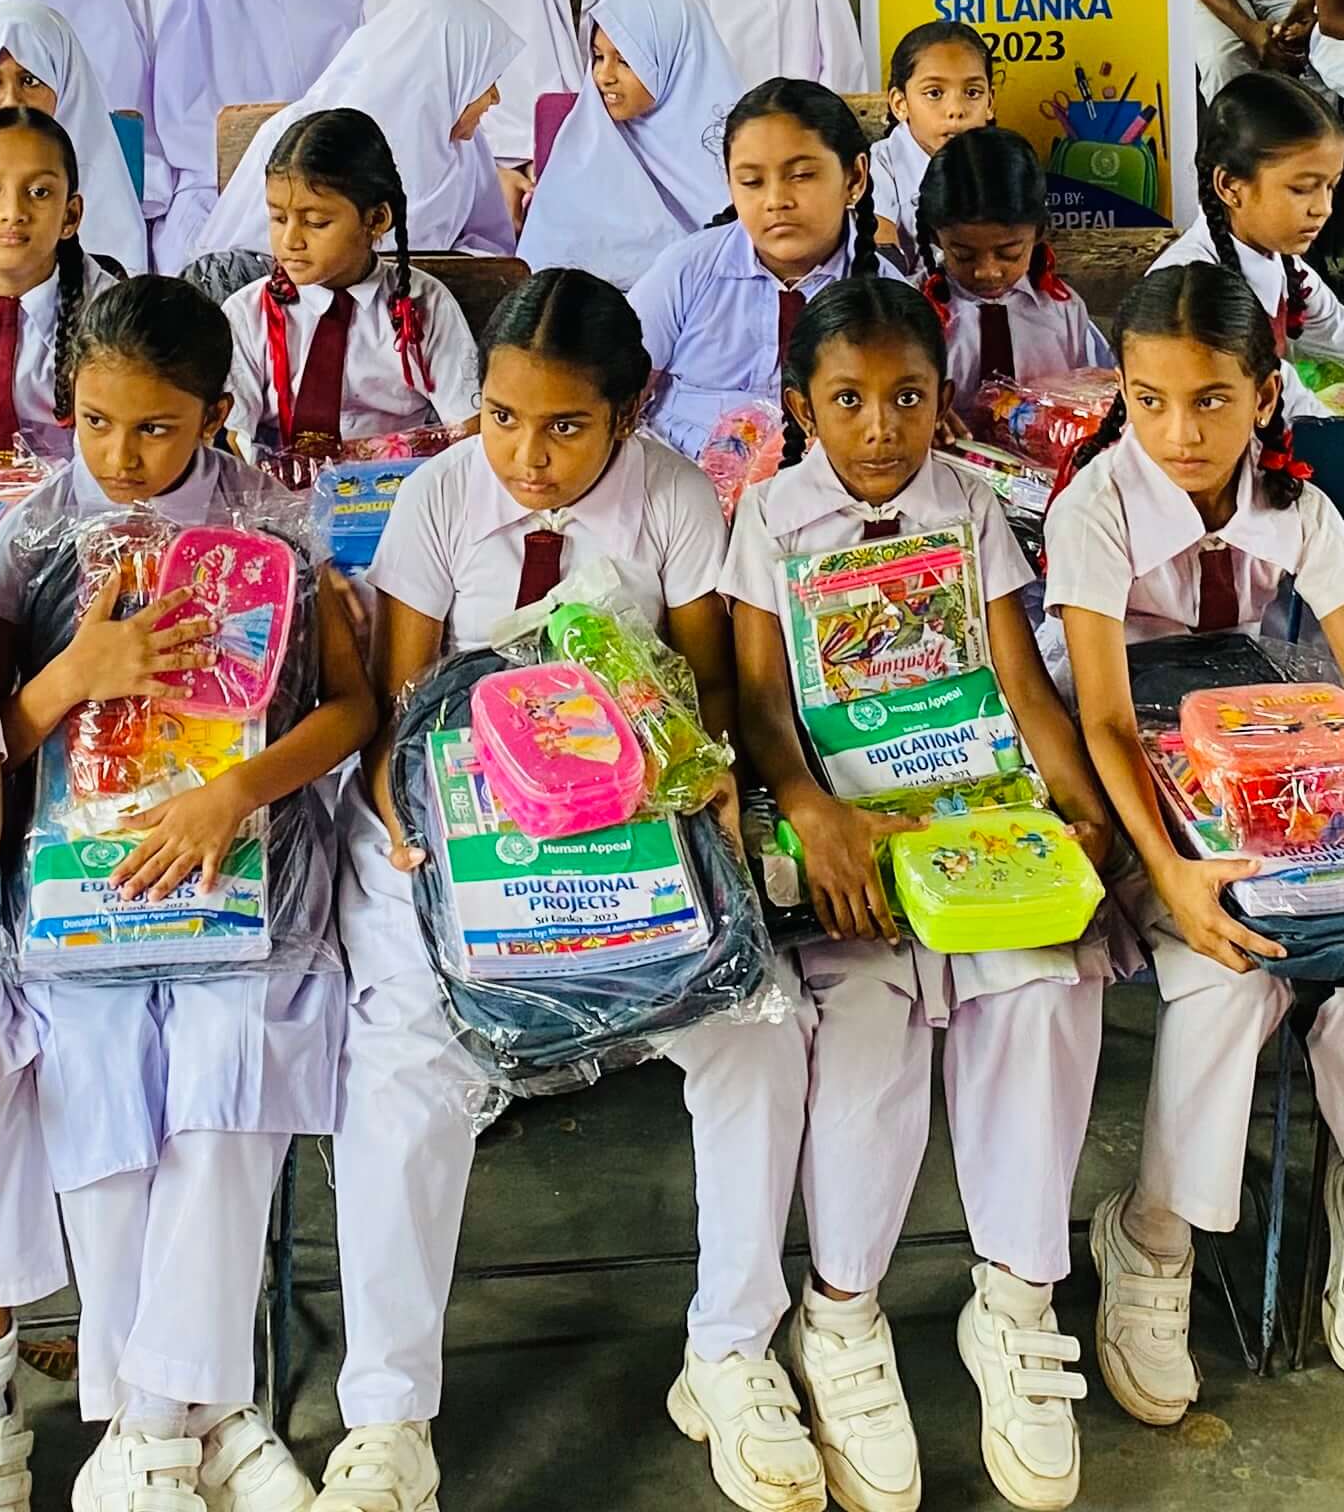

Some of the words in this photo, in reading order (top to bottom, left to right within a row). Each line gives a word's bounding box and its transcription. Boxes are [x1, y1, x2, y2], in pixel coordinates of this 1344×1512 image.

[984, 31, 1066, 63] 2023
[928, 687, 963, 708] Appeal
[866, 725, 979, 765] EDUCATIONAL
[892, 747, 969, 778] PROJECTS
[543, 842, 588, 855] Human
[589, 839, 631, 855] Appeal
[504, 876, 639, 897] EDUCATIONAL
[529, 894, 620, 914] PROJECTS
[592, 913, 619, 922] 2023
